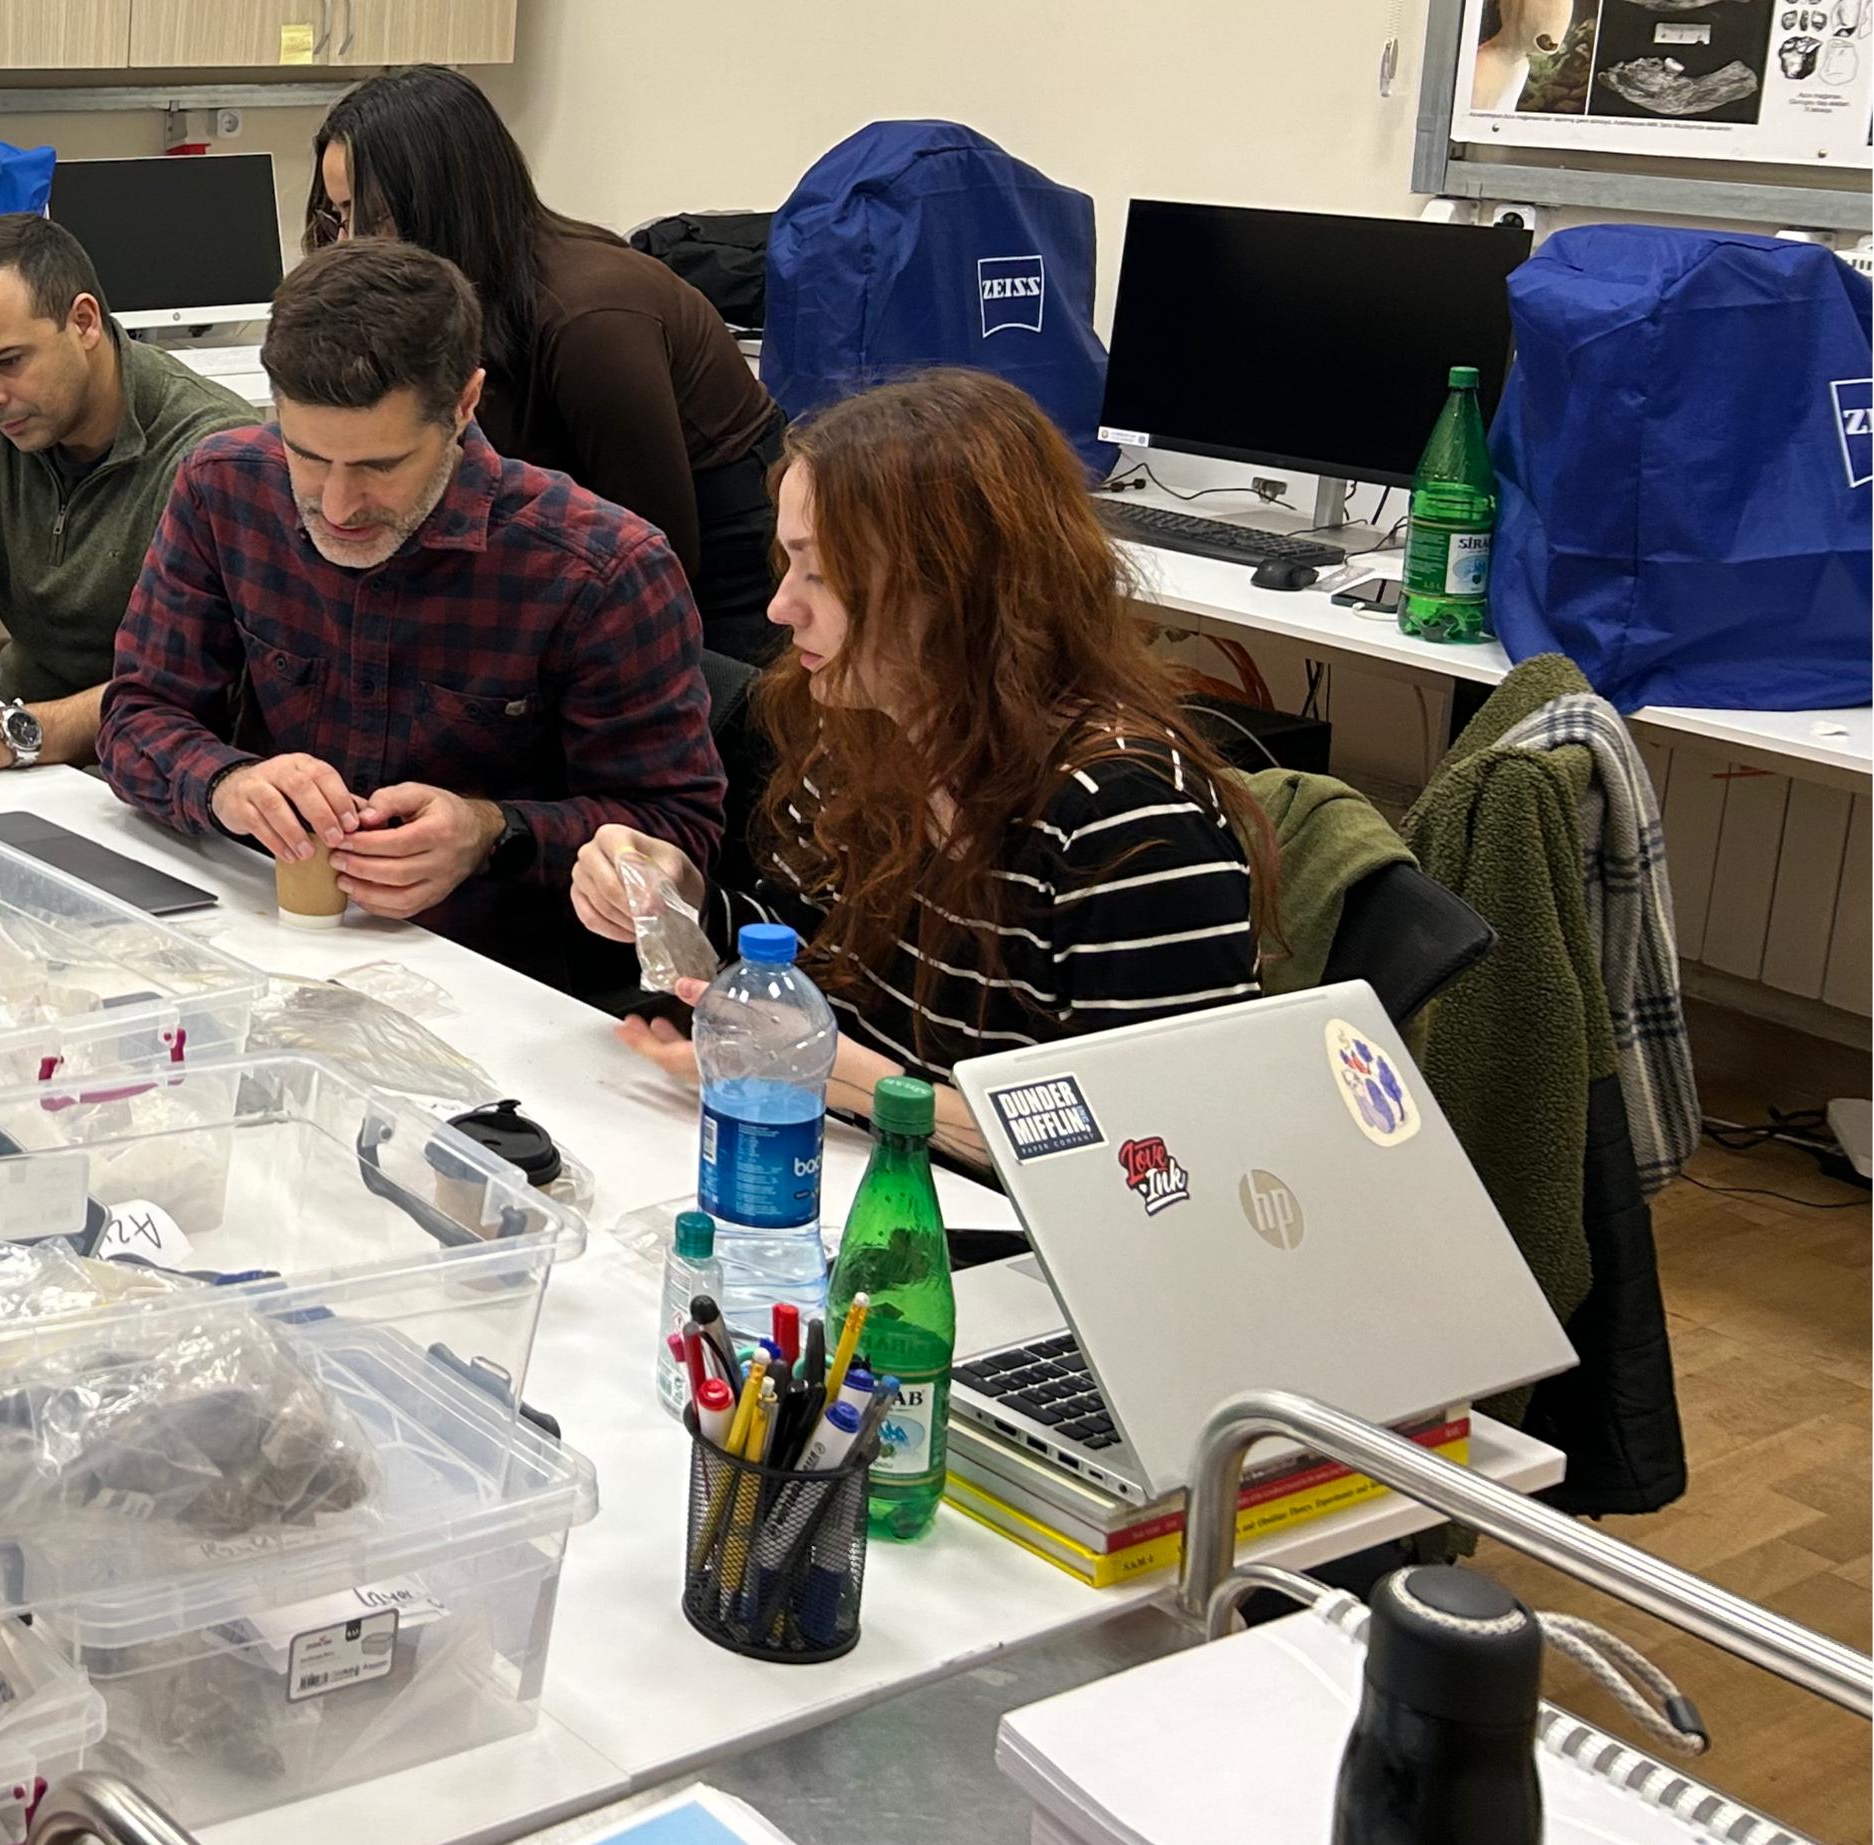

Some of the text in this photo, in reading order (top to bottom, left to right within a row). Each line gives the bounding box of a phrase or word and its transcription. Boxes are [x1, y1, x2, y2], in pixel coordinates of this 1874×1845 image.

[982, 276, 1041, 299] ZEISS
[998, 1081, 1077, 1119] DUNDER
[1022, 1133, 1095, 1155] PAPER COMPANY
[1120, 1141, 1168, 1184] Love
[1245, 1170, 1294, 1250] hp
[891, 1391, 924, 1406] AB
